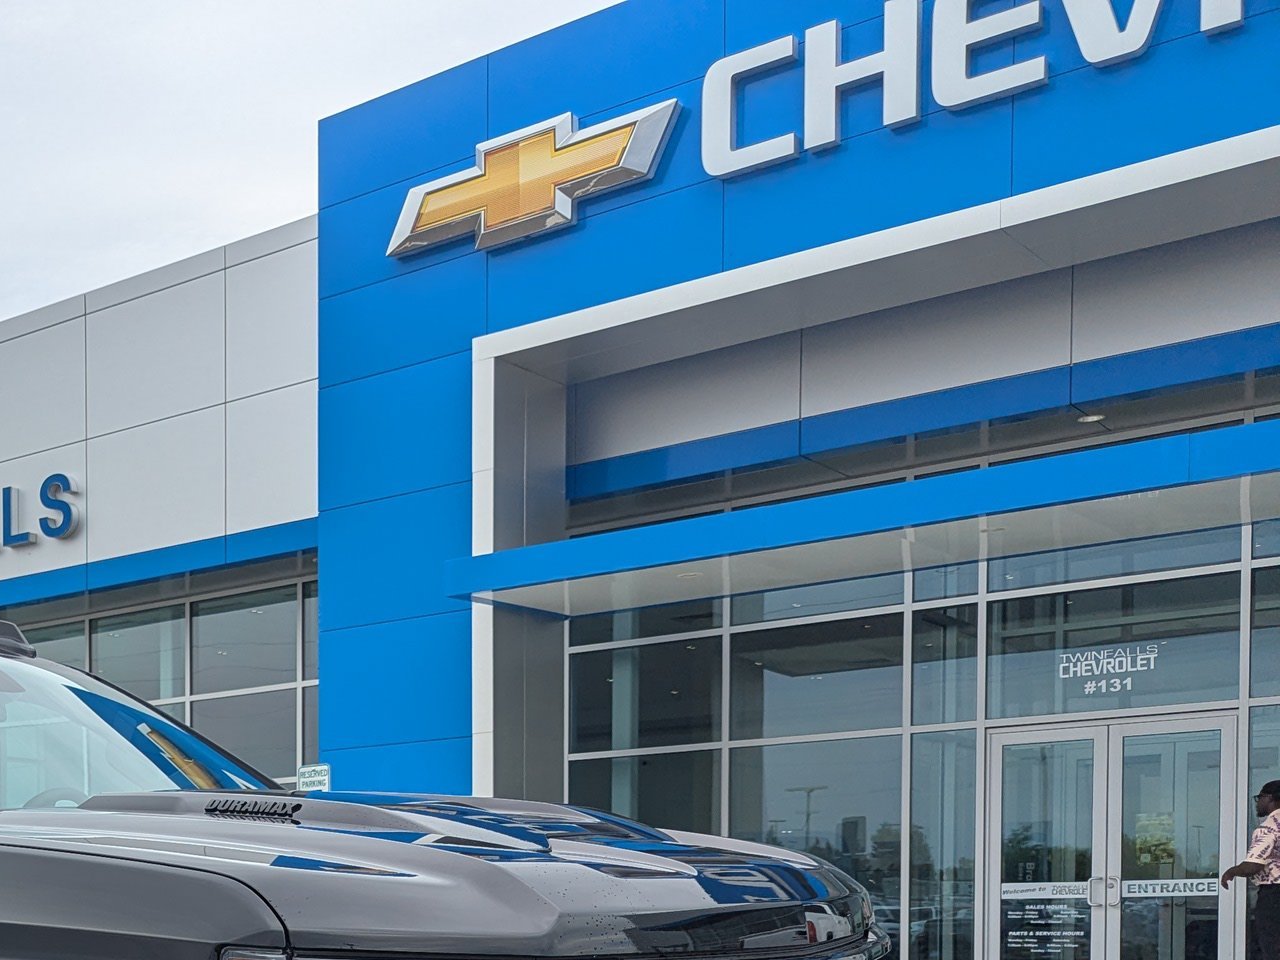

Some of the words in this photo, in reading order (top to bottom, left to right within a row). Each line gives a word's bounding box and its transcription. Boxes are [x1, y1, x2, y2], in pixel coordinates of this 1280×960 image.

[701, 0, 1244, 178] CHEV
[1059, 654, 1158, 678] CHEVROLET
[1084, 677, 1132, 694] #131
[299, 769, 328, 778] RESERVED
[301, 781, 326, 789] PARKING
[205, 799, 302, 817] DURAMAX
[1127, 882, 1217, 894] ENTRANCE
